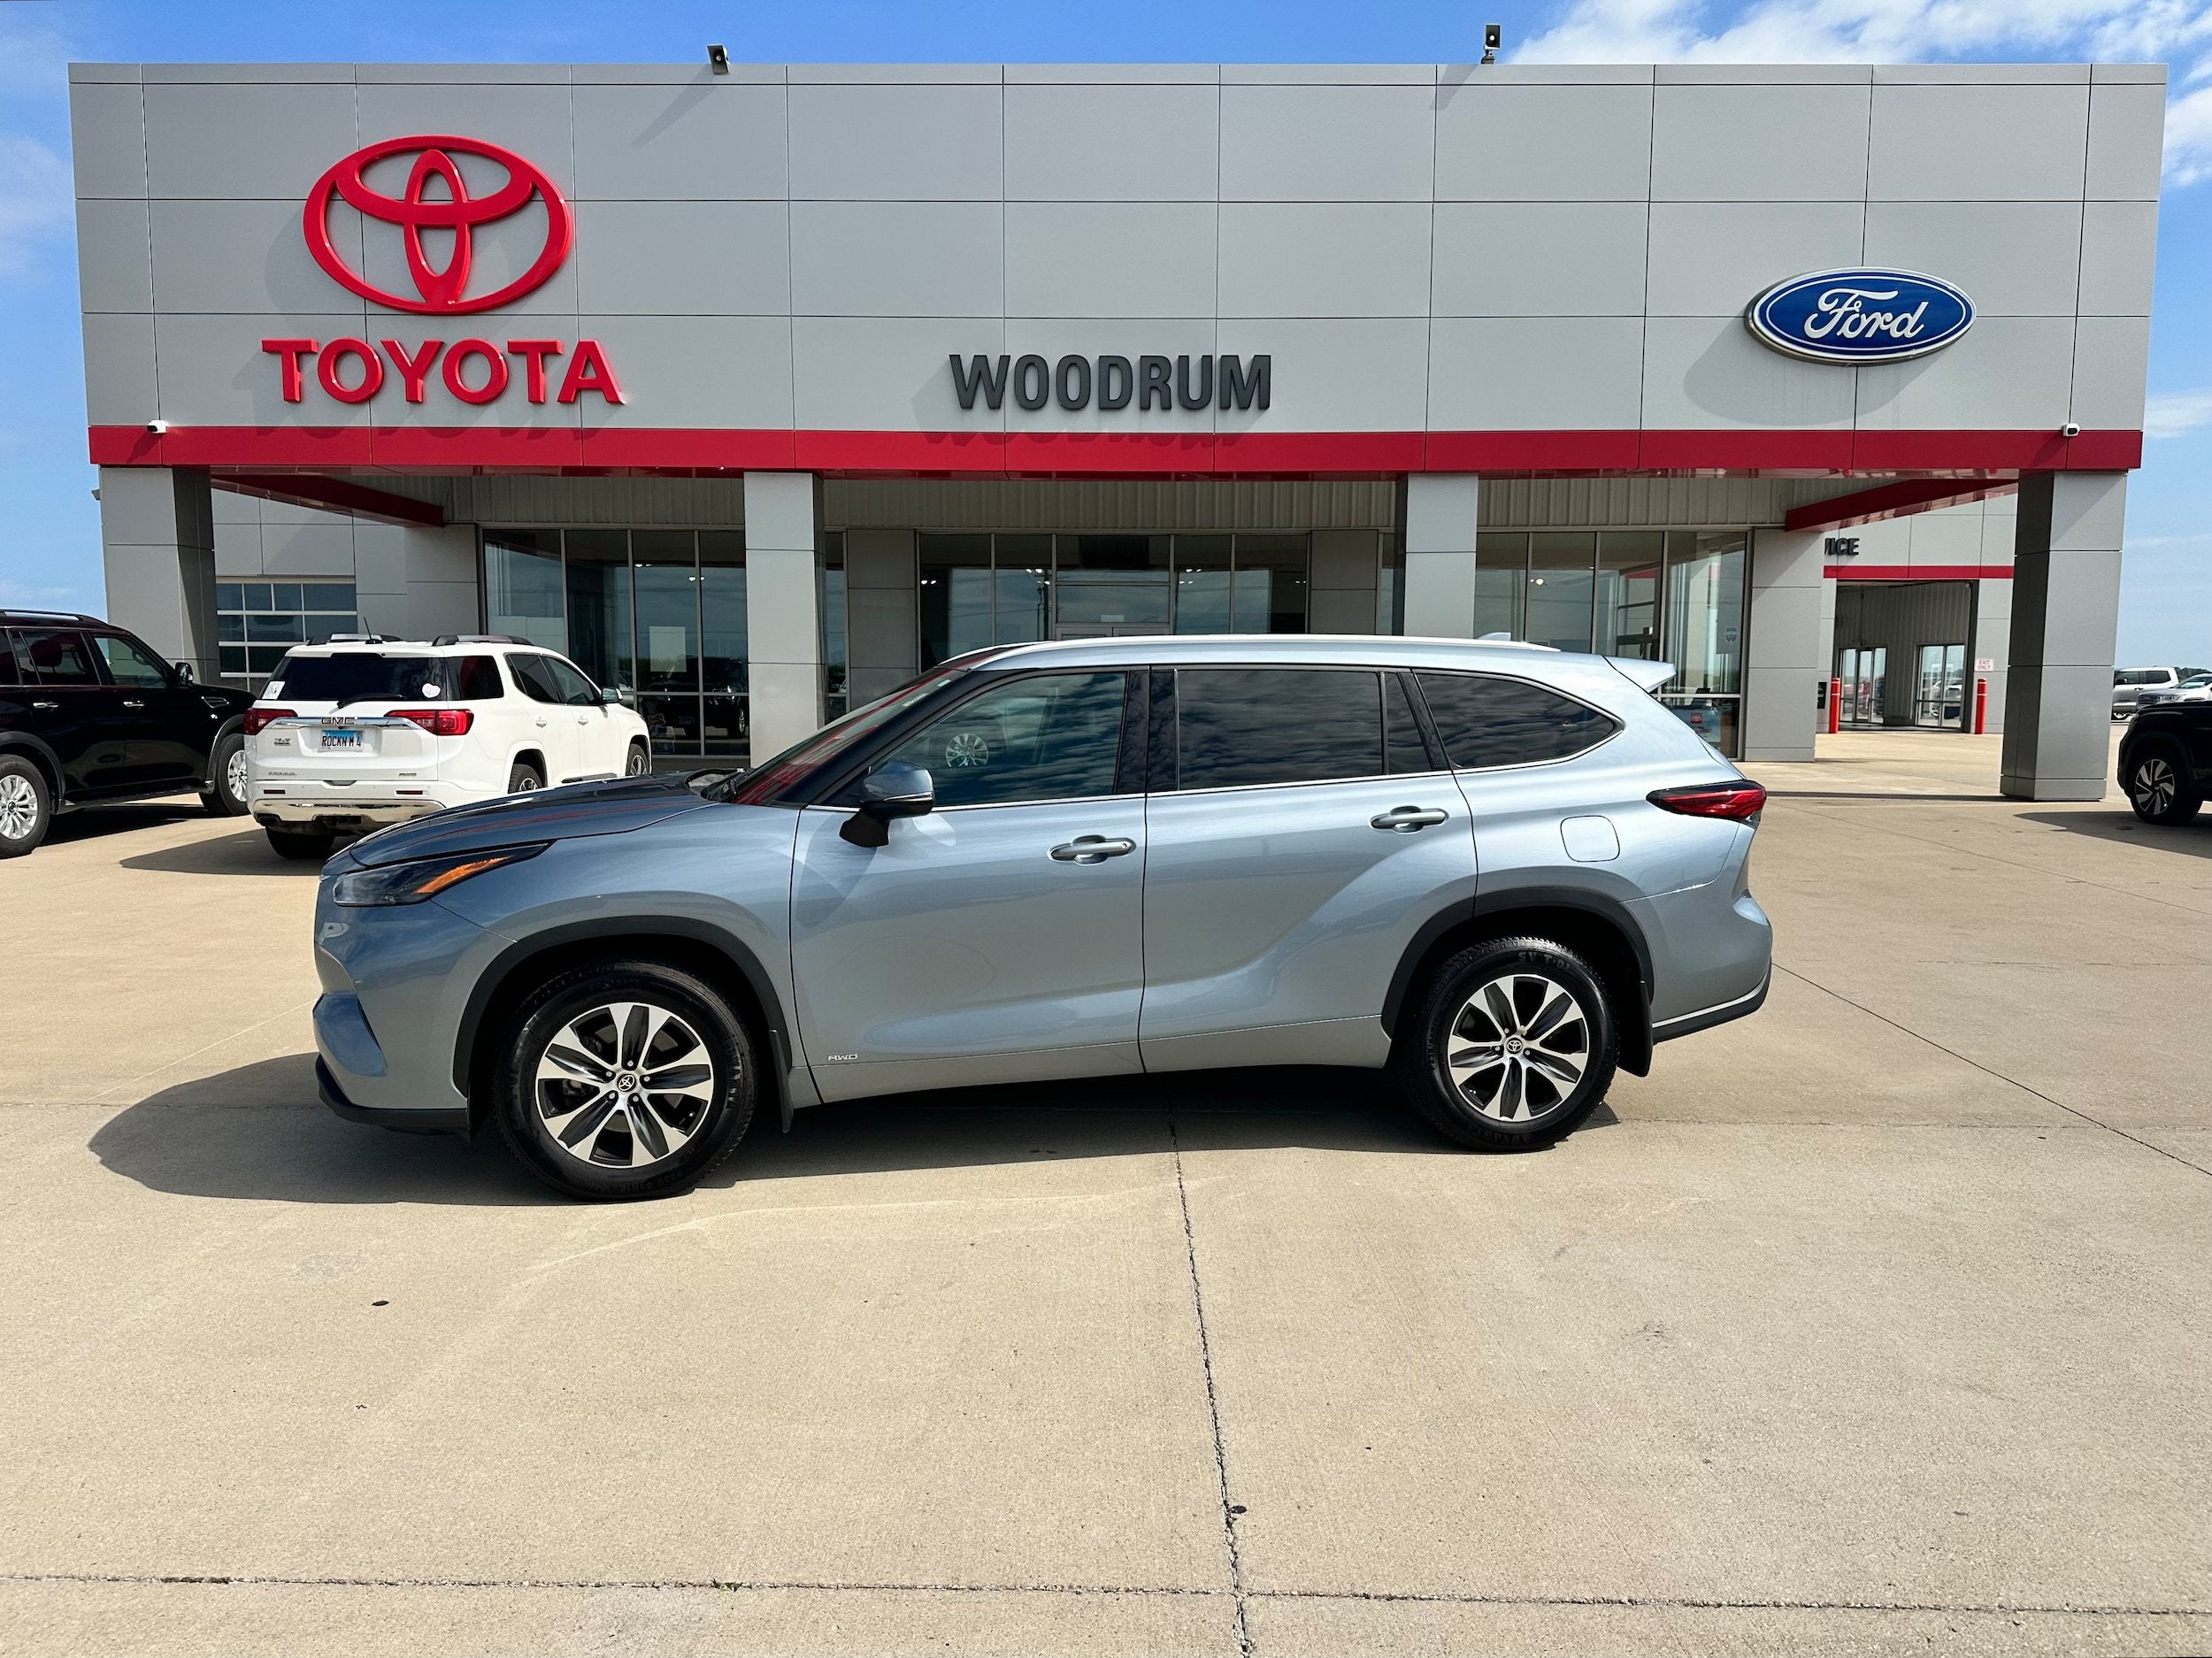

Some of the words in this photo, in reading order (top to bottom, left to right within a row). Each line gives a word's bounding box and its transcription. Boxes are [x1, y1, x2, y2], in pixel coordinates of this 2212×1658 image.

[1803, 288, 1930, 339] Ford
[261, 338, 624, 405] TOYOTA
[949, 354, 1271, 411] WOODRUM
[321, 735, 347, 747] ROCKN
